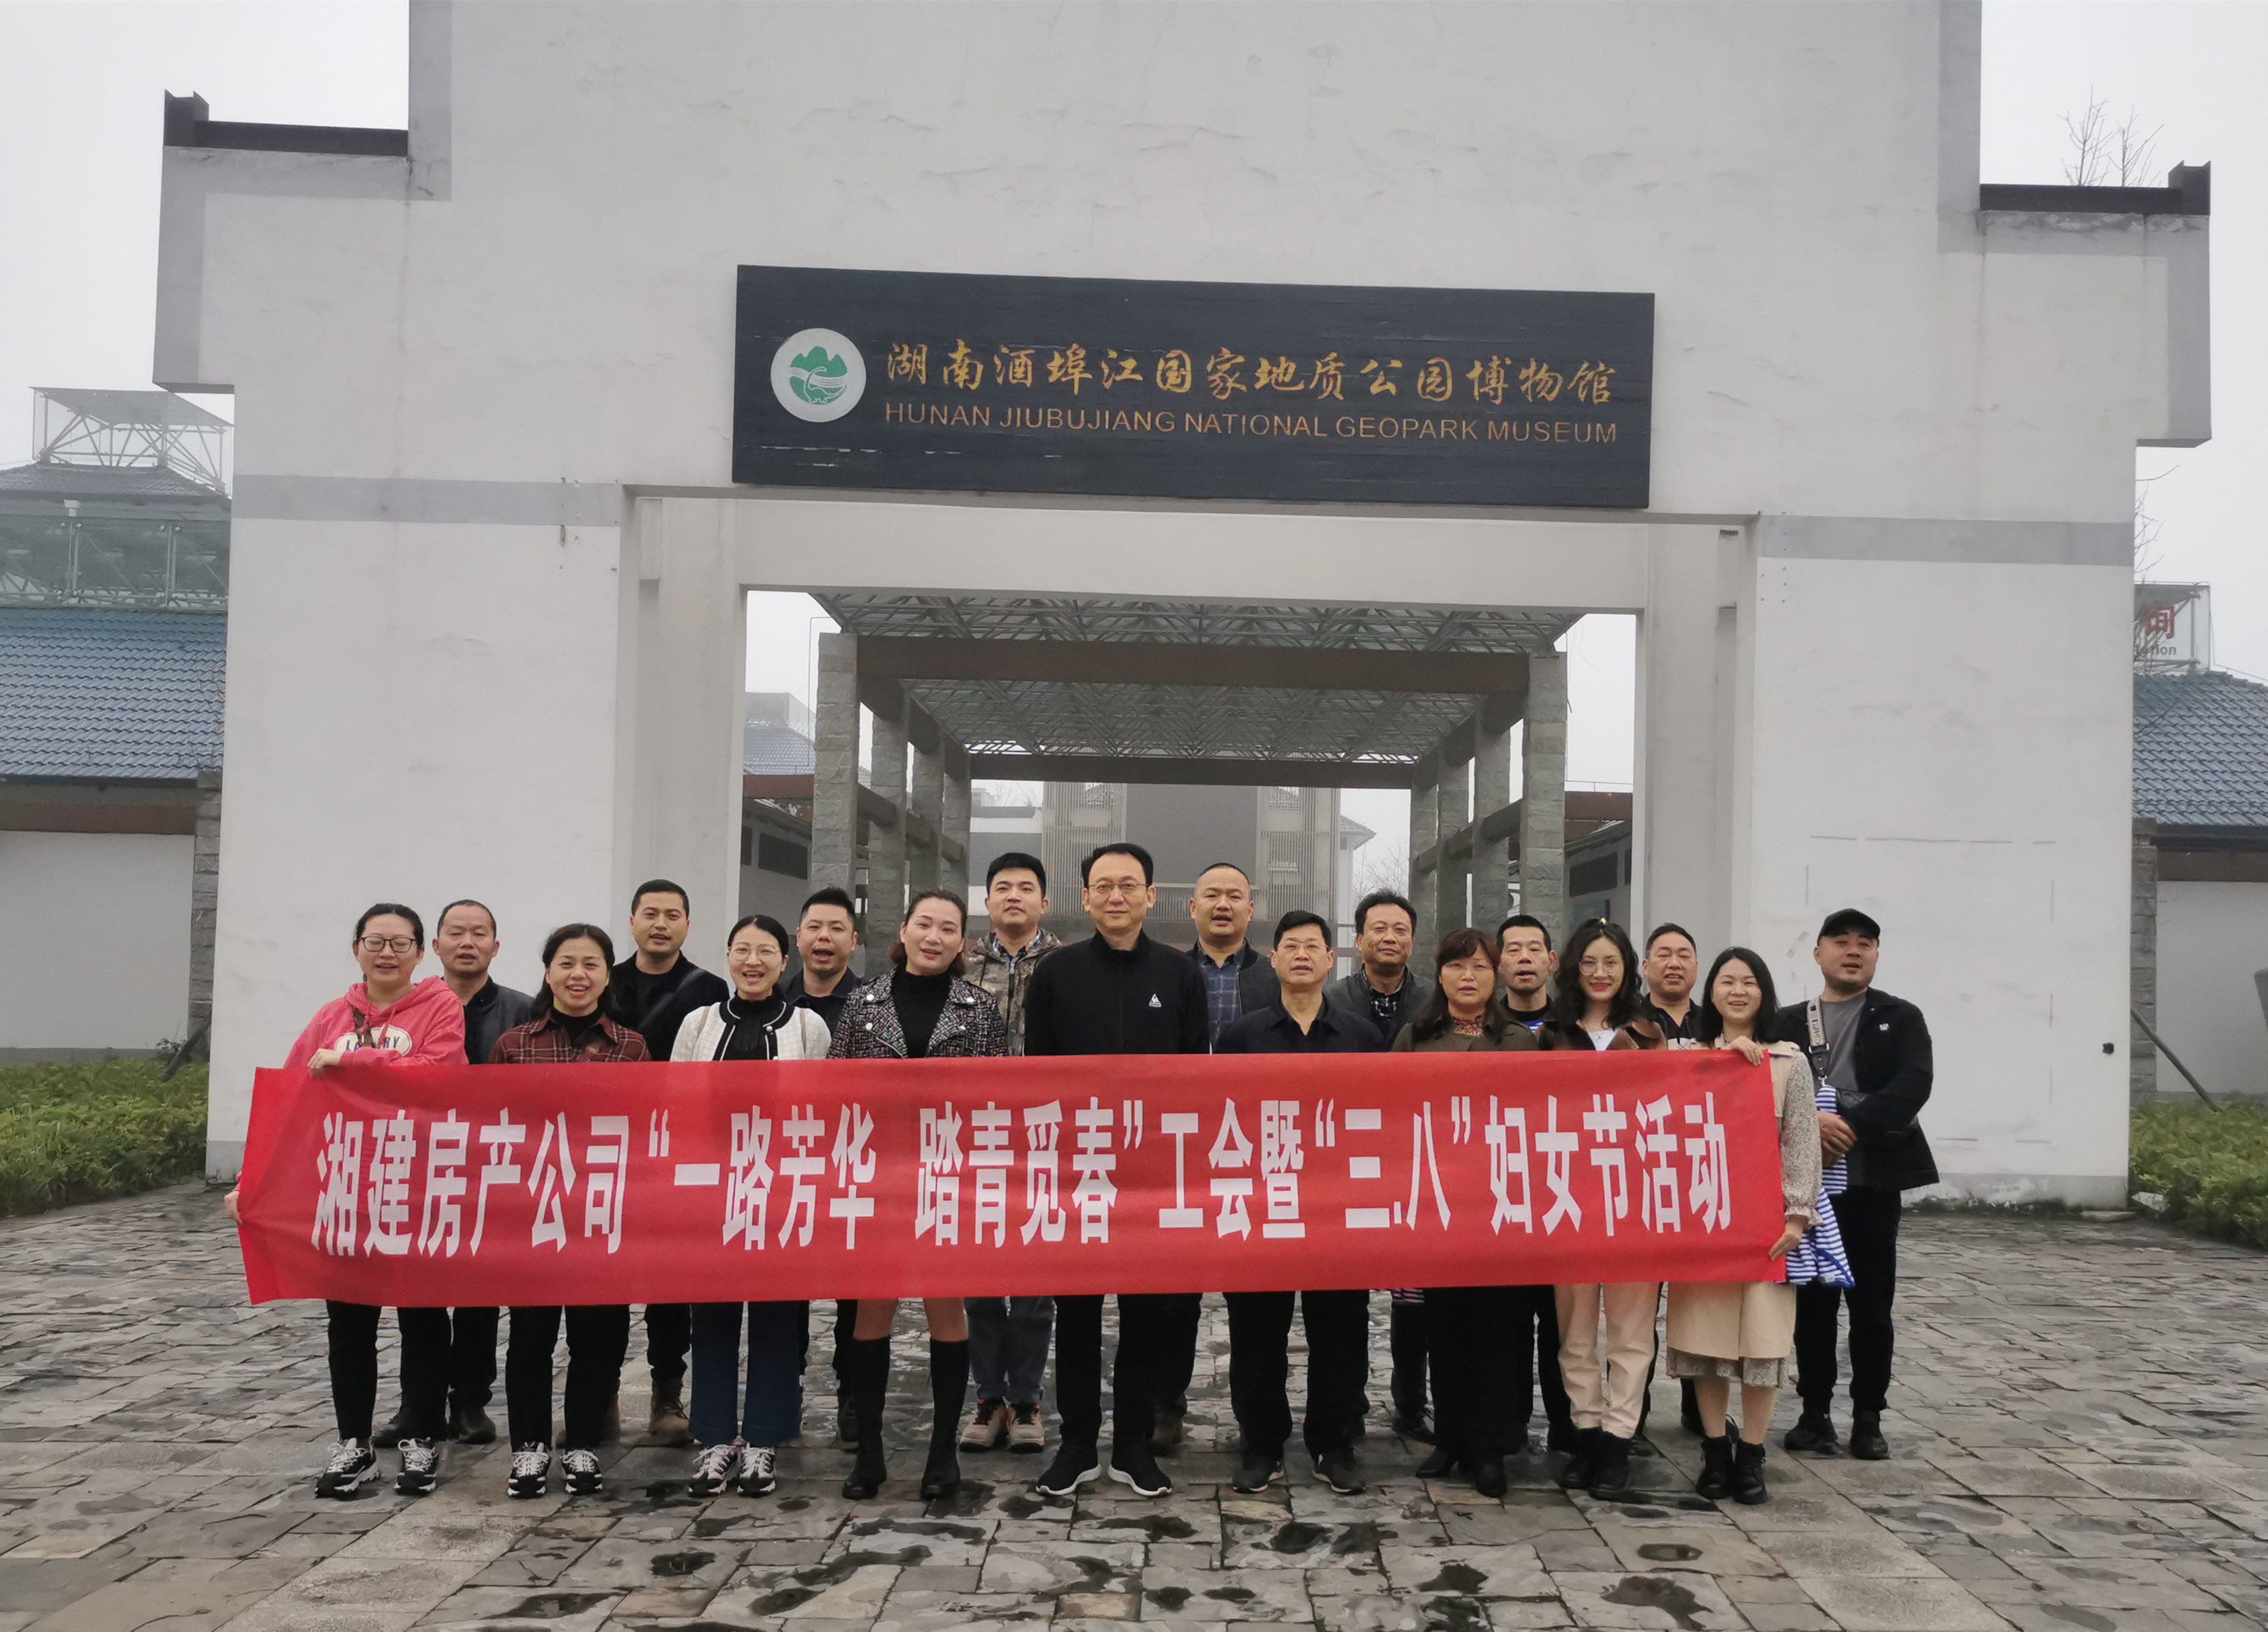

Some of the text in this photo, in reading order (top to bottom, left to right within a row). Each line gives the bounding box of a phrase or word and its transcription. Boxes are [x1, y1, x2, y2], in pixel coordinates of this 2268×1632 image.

[887, 339, 1616, 406] 湖南酒埠江国家地质公园博物馆
[886, 403, 1617, 443] HUNAN JIUBUJIANG NATIONAL GEOPARK MUSEUM
